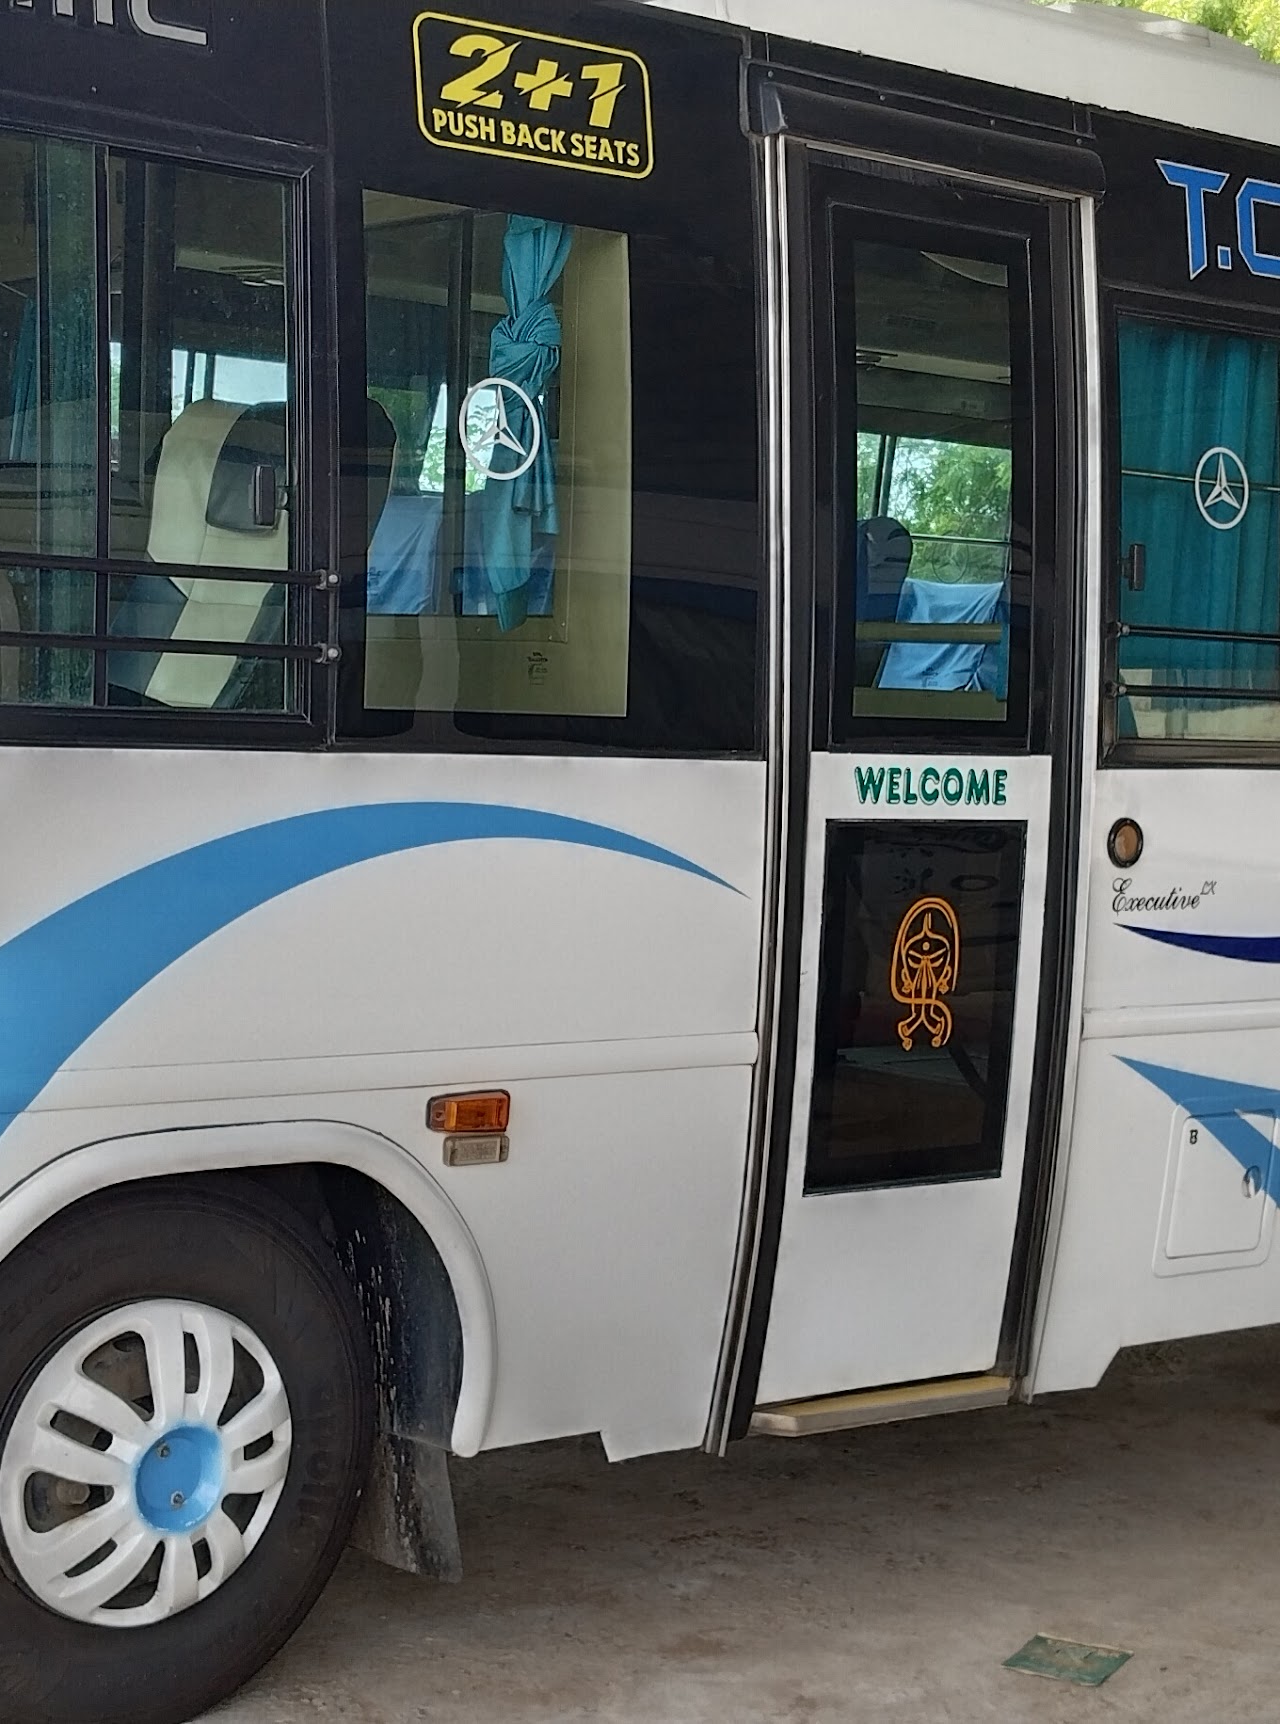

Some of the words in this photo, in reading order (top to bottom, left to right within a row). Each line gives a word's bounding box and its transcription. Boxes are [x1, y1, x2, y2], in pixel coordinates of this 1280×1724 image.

[440, 34, 626, 128] 2+1
[432, 108, 495, 142] PUSH
[501, 119, 567, 155] BACK
[570, 133, 640, 167] SEATS
[854, 766, 1008, 806] WELCOME
[1112, 877, 1200, 917] Executive
